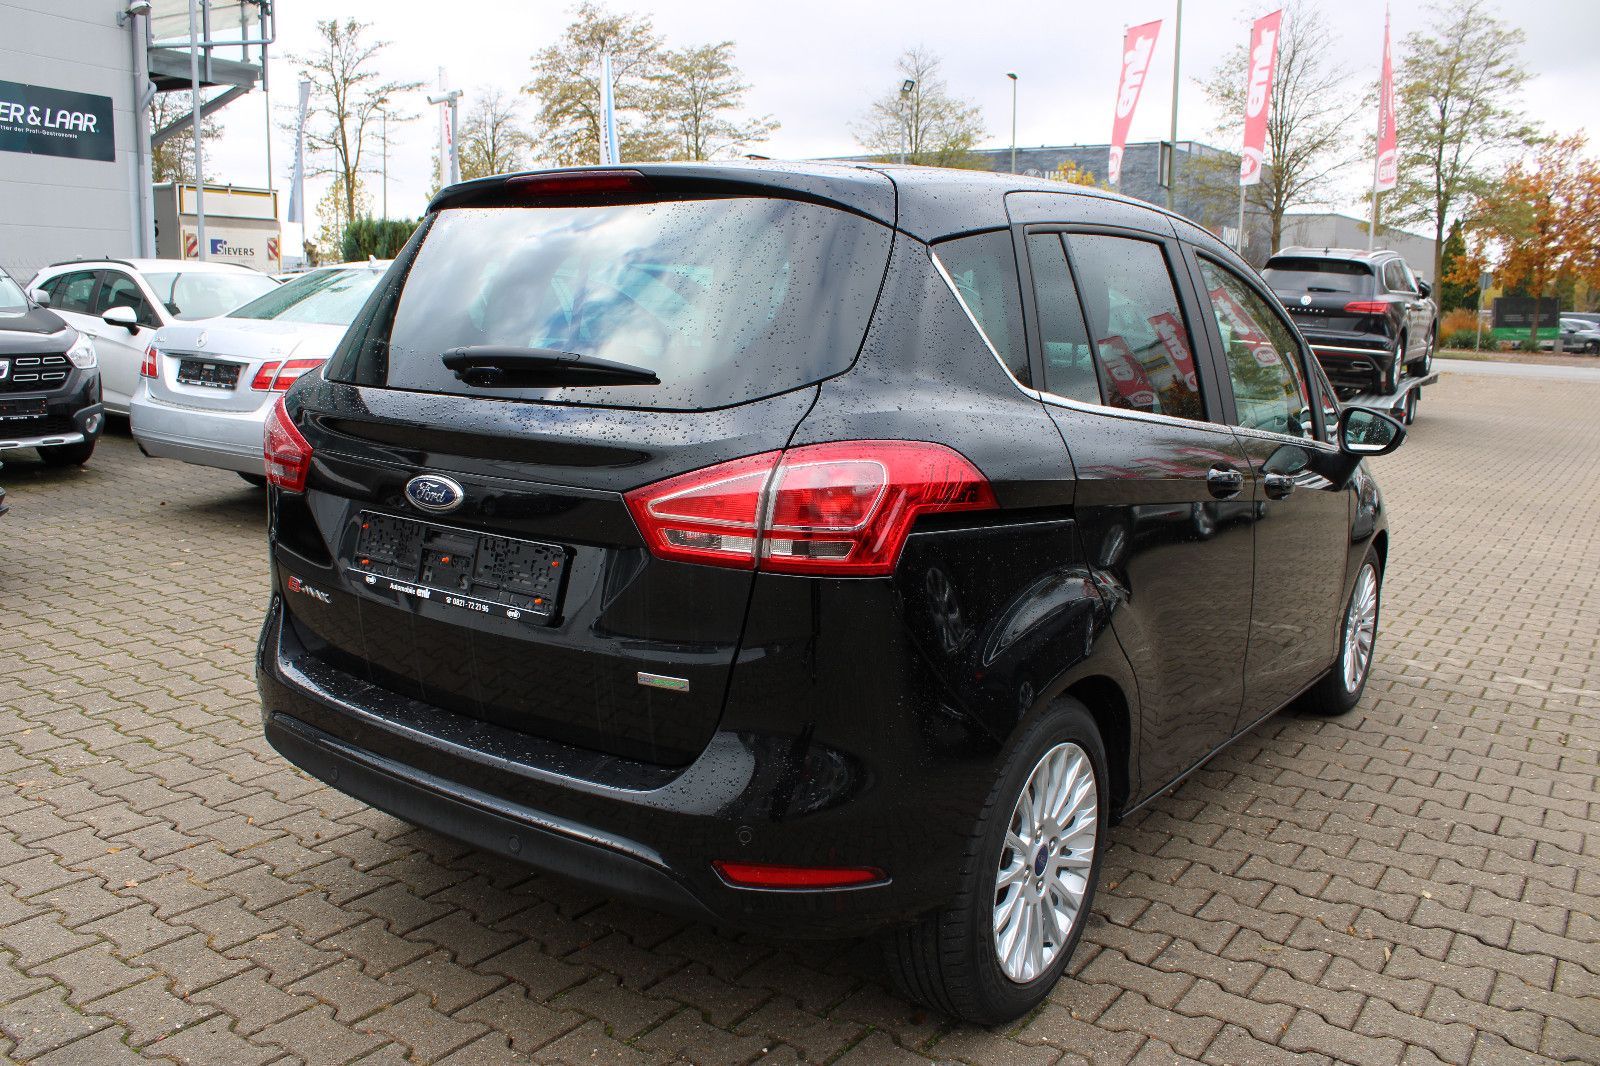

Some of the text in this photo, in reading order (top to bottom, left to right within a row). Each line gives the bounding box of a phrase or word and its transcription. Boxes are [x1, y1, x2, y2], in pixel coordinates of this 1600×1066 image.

[27, 105, 42, 126] &
[44, 108, 97, 133] LAAR
[416, 481, 447, 503] Ford
[389, 582, 416, 595] Automobile
